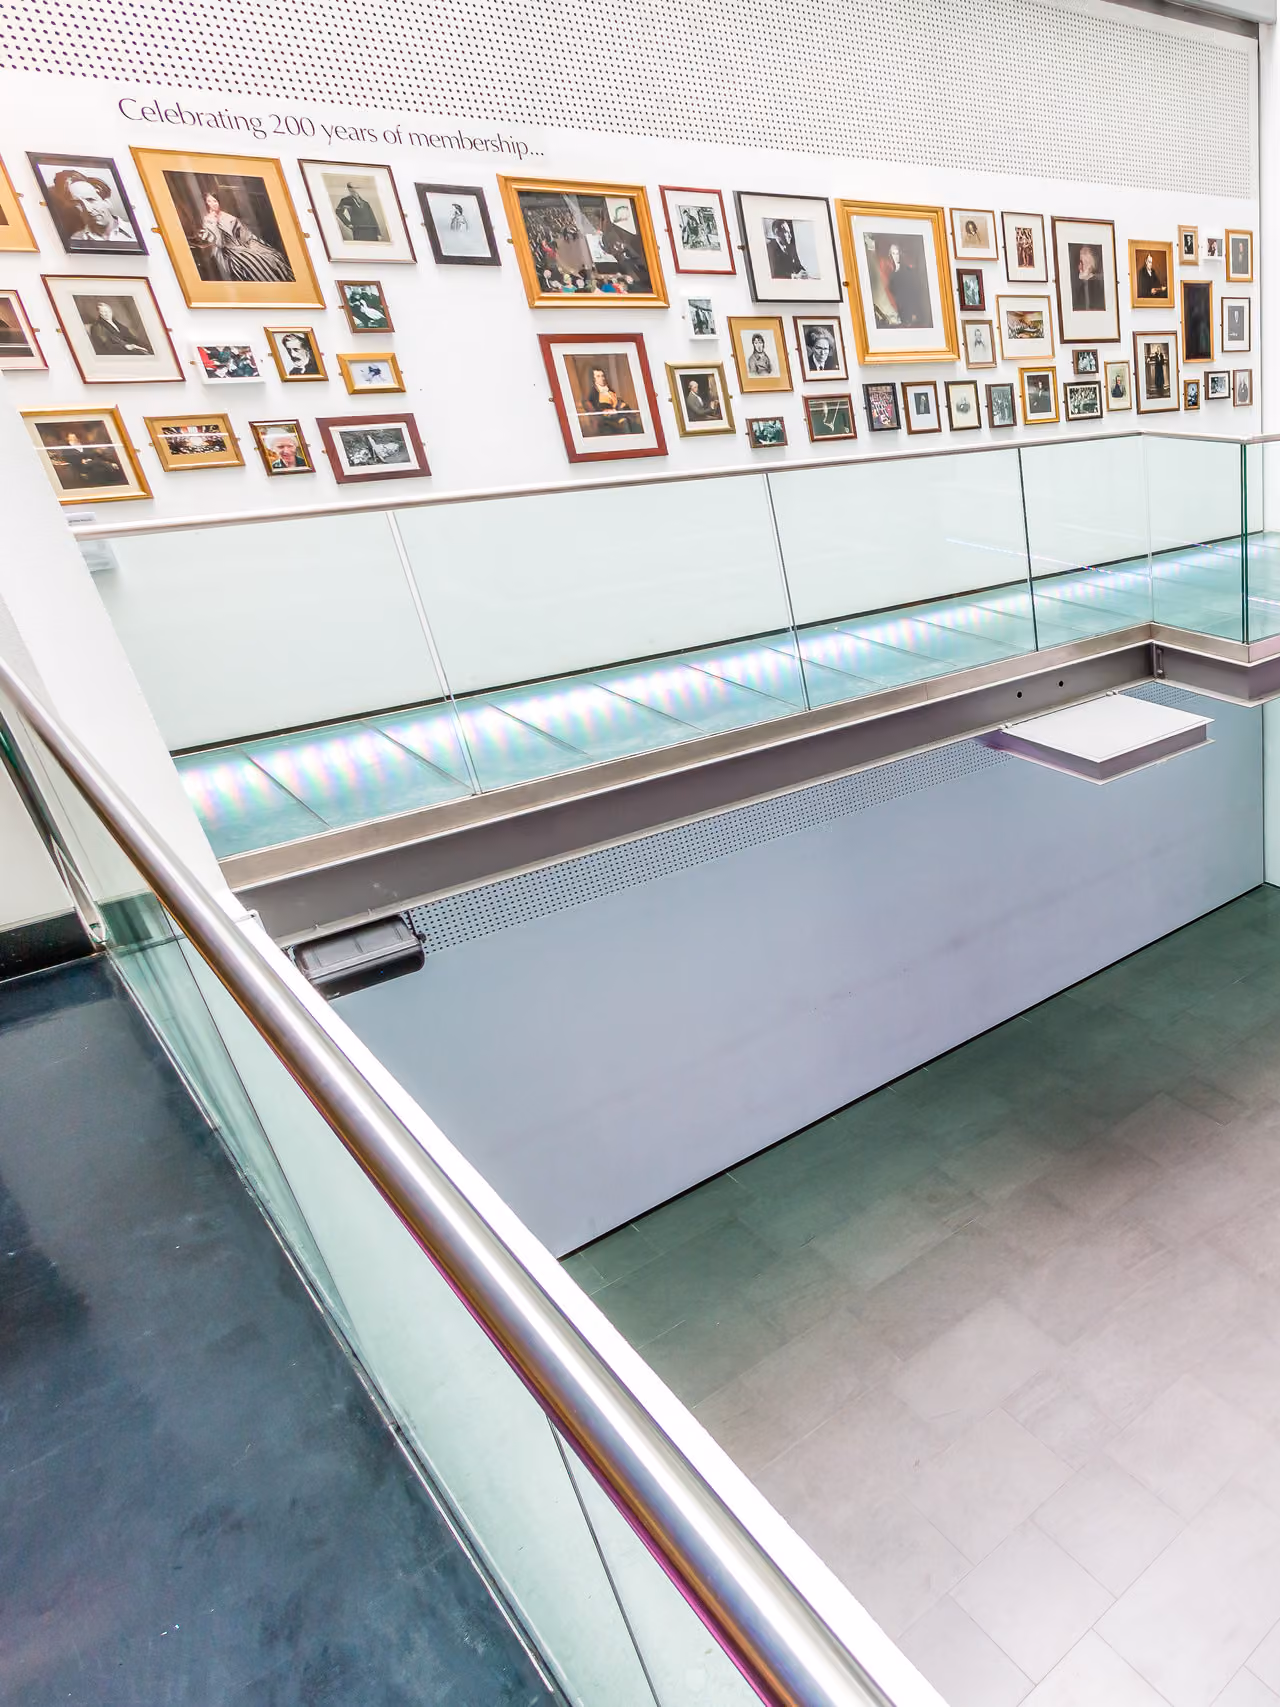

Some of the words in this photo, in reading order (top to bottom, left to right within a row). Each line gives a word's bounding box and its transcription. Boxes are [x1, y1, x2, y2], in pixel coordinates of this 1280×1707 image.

[118, 97, 268, 140] Celebrating
[268, 113, 316, 138] 200
[320, 123, 378, 146] years
[383, 124, 403, 145] of
[408, 129, 545, 160] membership...
